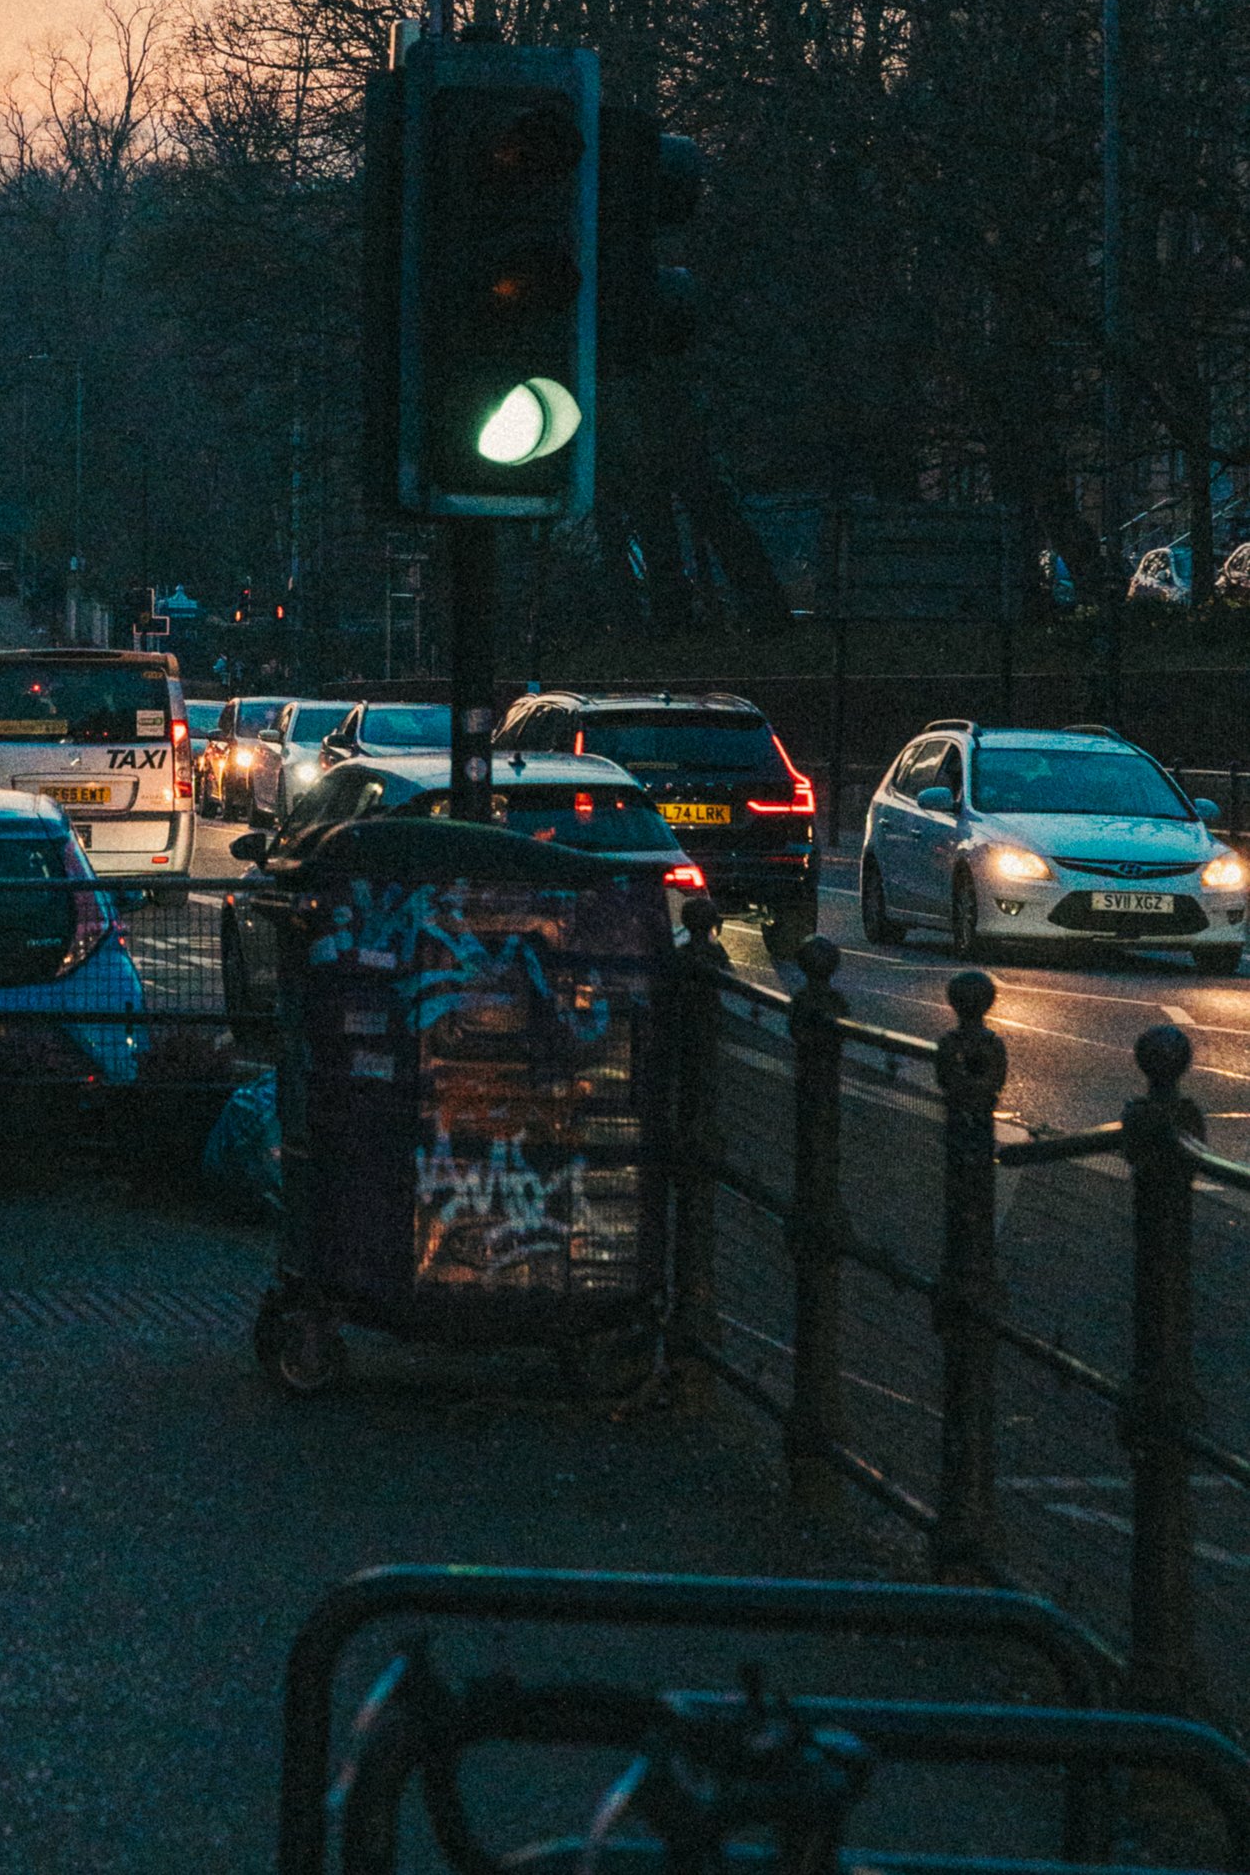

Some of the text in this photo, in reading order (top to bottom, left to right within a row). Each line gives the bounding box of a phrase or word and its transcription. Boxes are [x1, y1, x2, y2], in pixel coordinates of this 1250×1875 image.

[106, 749, 167, 769] TAXI
[696, 807, 725, 821] LRK
[1104, 894, 1163, 910] SV11 XGZ
